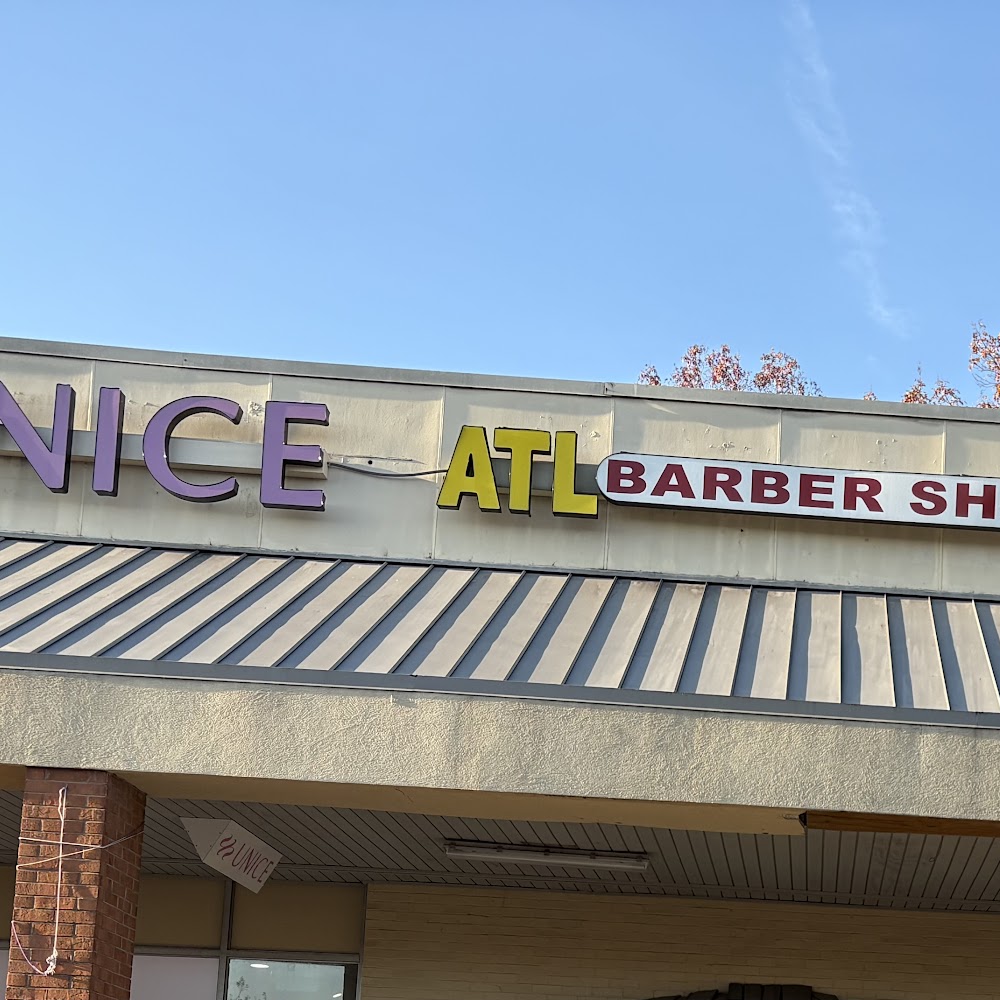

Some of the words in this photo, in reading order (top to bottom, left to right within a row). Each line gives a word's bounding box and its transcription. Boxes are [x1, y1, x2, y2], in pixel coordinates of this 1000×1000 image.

[437, 425, 598, 519] ATL
[606, 459, 884, 513] BARBER
[232, 843, 274, 883] UNICE
